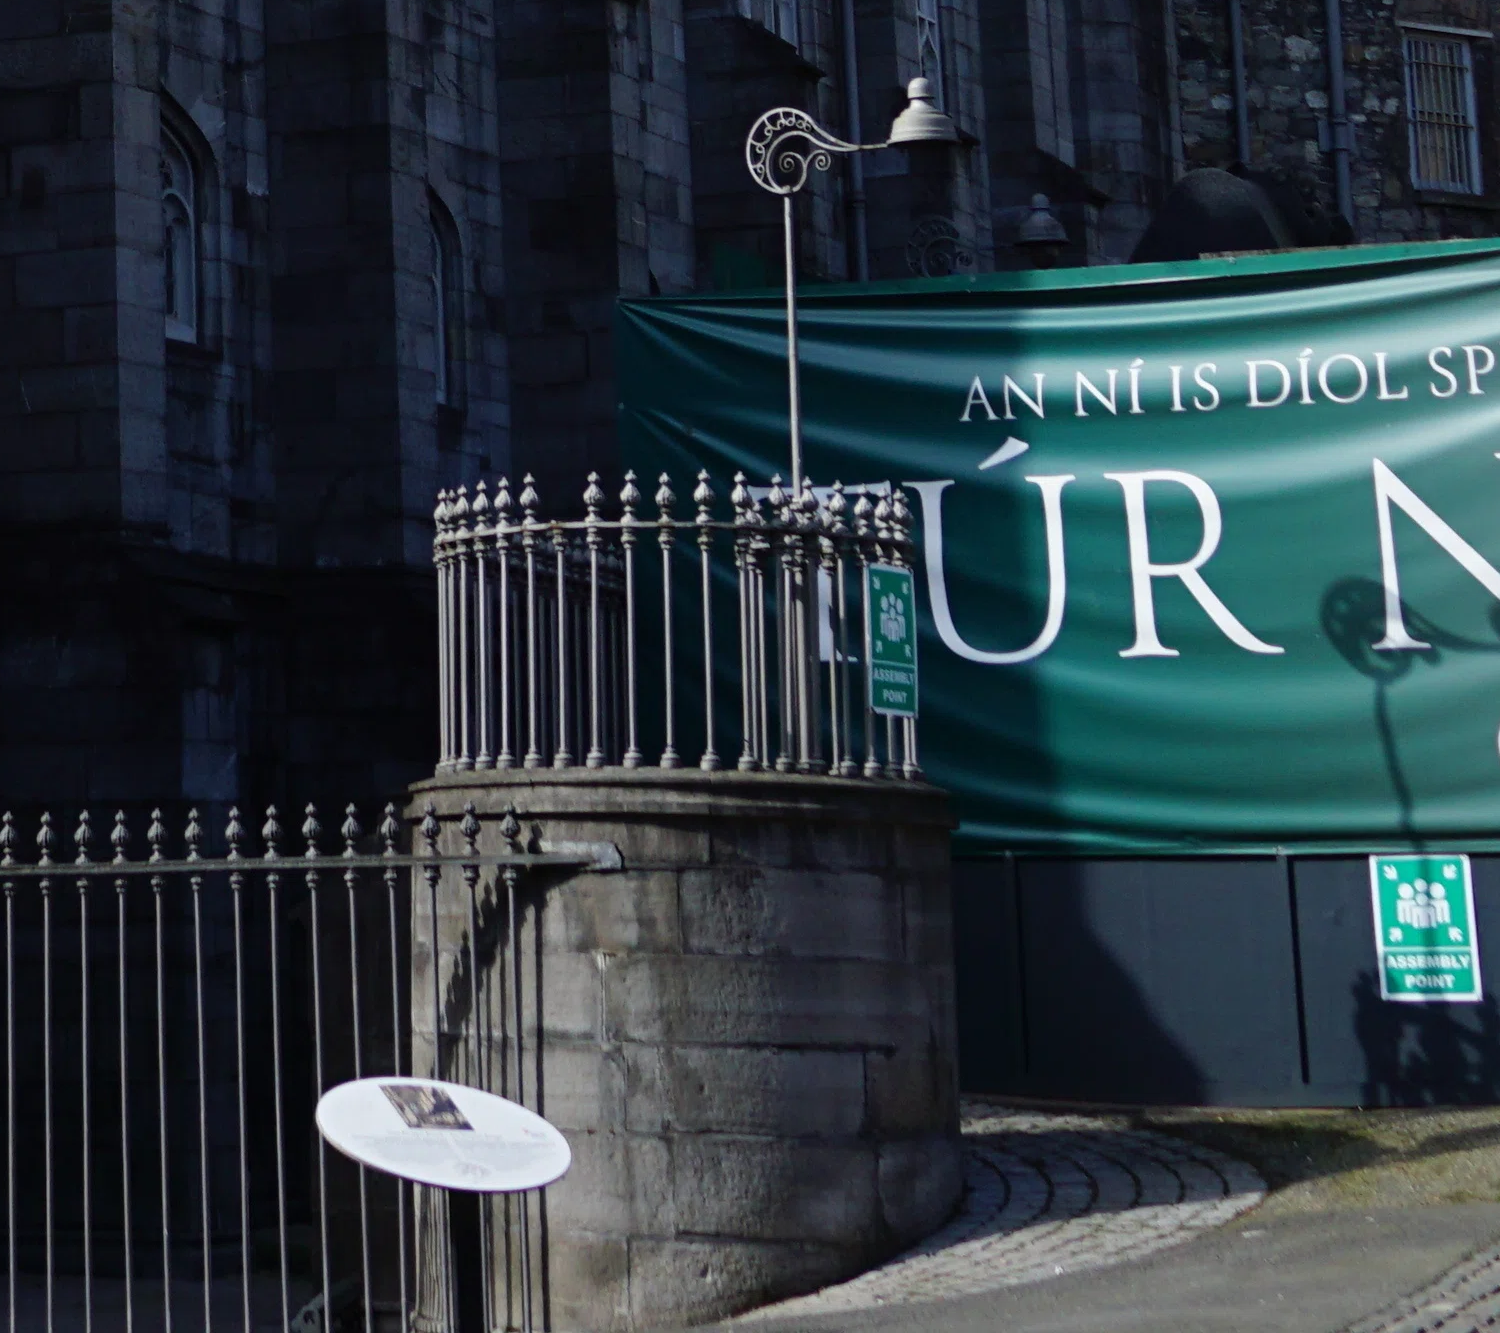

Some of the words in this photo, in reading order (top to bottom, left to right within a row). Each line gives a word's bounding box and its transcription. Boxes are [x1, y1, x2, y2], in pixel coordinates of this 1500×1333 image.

[959, 373, 1046, 421] AN
[1075, 357, 1145, 416] NÍ
[1169, 363, 1220, 411] IS
[1244, 347, 1408, 407] DÍOL
[873, 667, 914, 685] ASSEMBLY
[882, 689, 907, 704] POINT
[1386, 954, 1471, 970] ASSEMBLY
[1404, 973, 1456, 989] POINT
